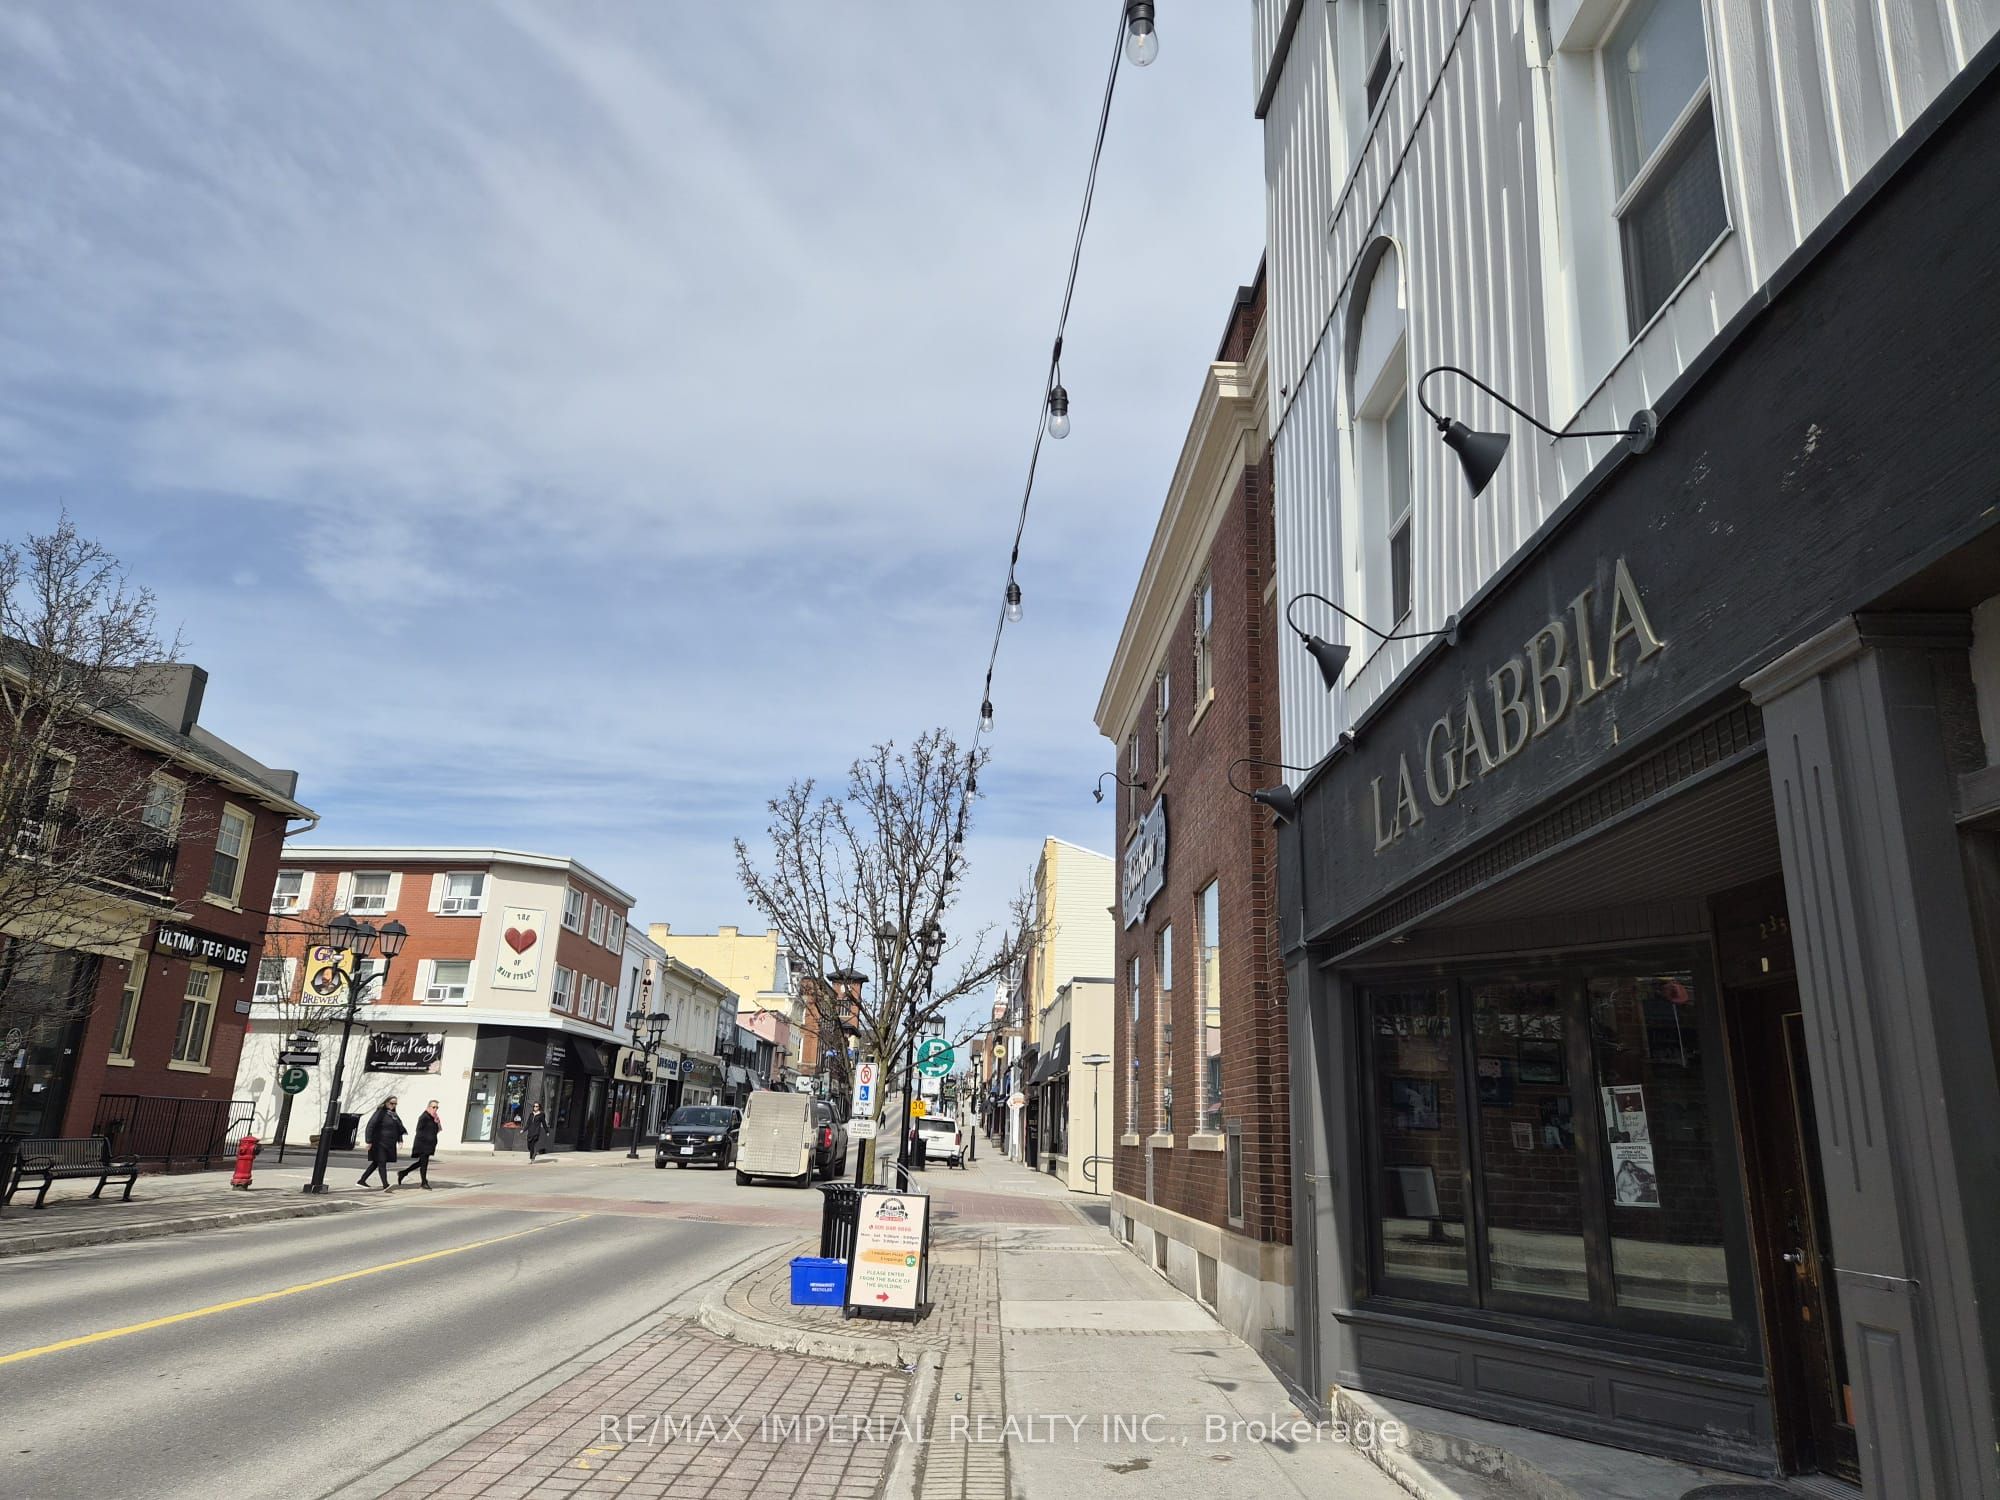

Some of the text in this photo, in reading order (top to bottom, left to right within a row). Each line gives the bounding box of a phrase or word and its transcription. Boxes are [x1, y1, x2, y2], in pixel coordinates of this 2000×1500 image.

[1370, 558, 1665, 856] LA GABBIA
[289, 1069, 303, 1084] P
[912, 1101, 924, 1110] 30
